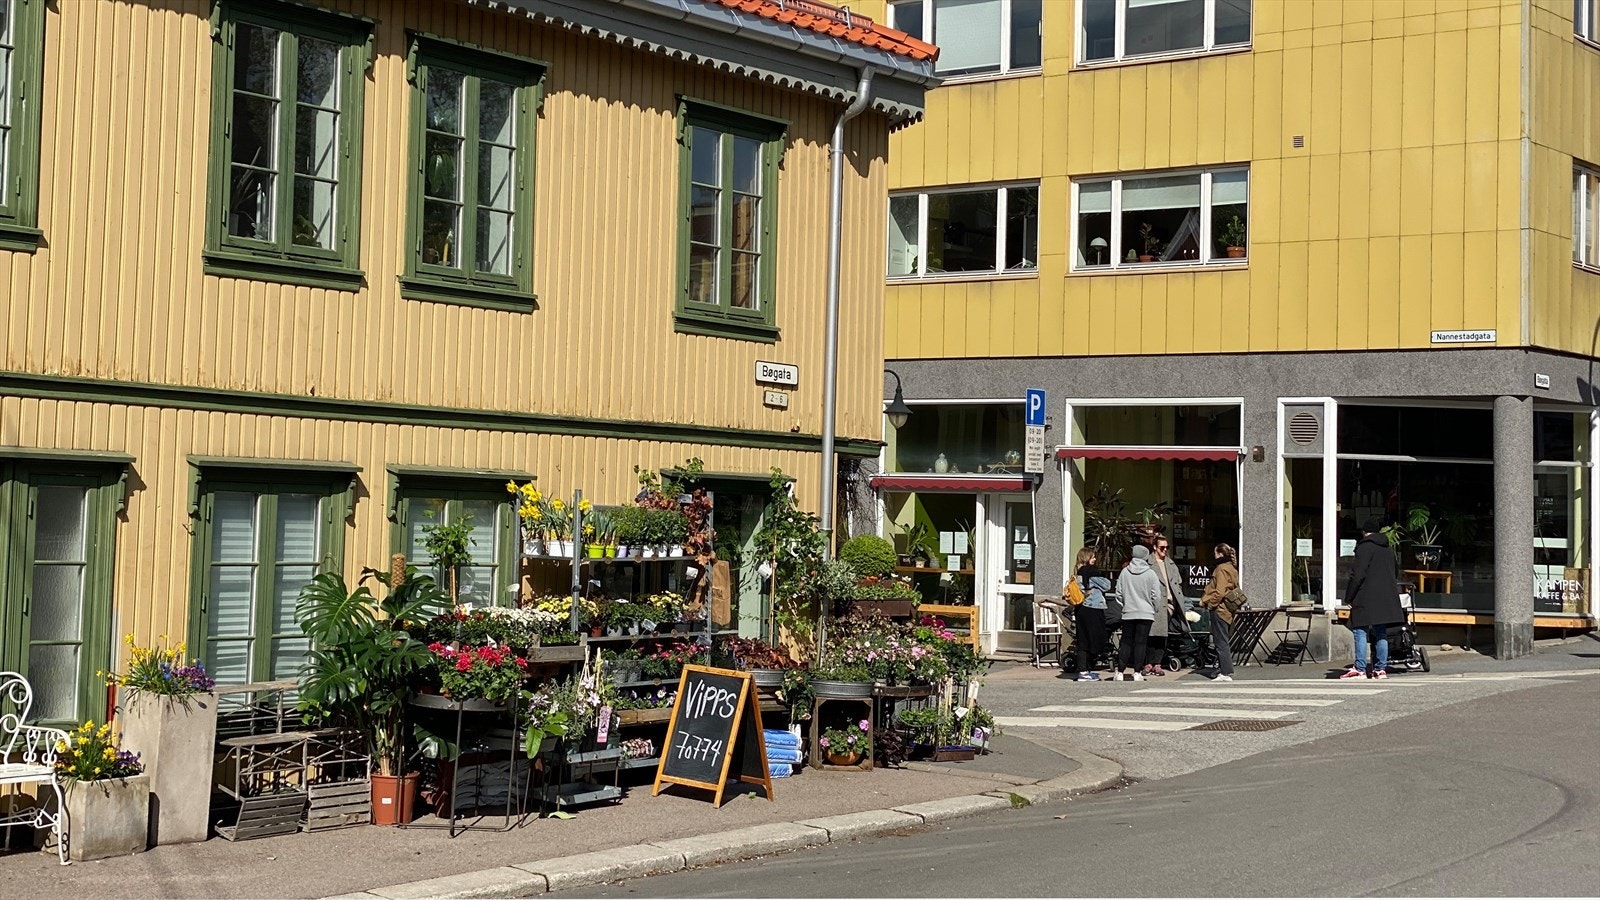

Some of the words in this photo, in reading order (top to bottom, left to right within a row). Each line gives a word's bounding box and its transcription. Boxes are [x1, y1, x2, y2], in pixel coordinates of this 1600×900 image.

[1436, 333, 1491, 341] Nannestadgata
[762, 365, 791, 381] Bøgata
[1031, 394, 1041, 420] P
[1536, 579, 1584, 590] KAMPEN
[1537, 591, 1559, 600] KAFFE
[1561, 592, 1568, 600] &
[676, 730, 723, 767] 70774
